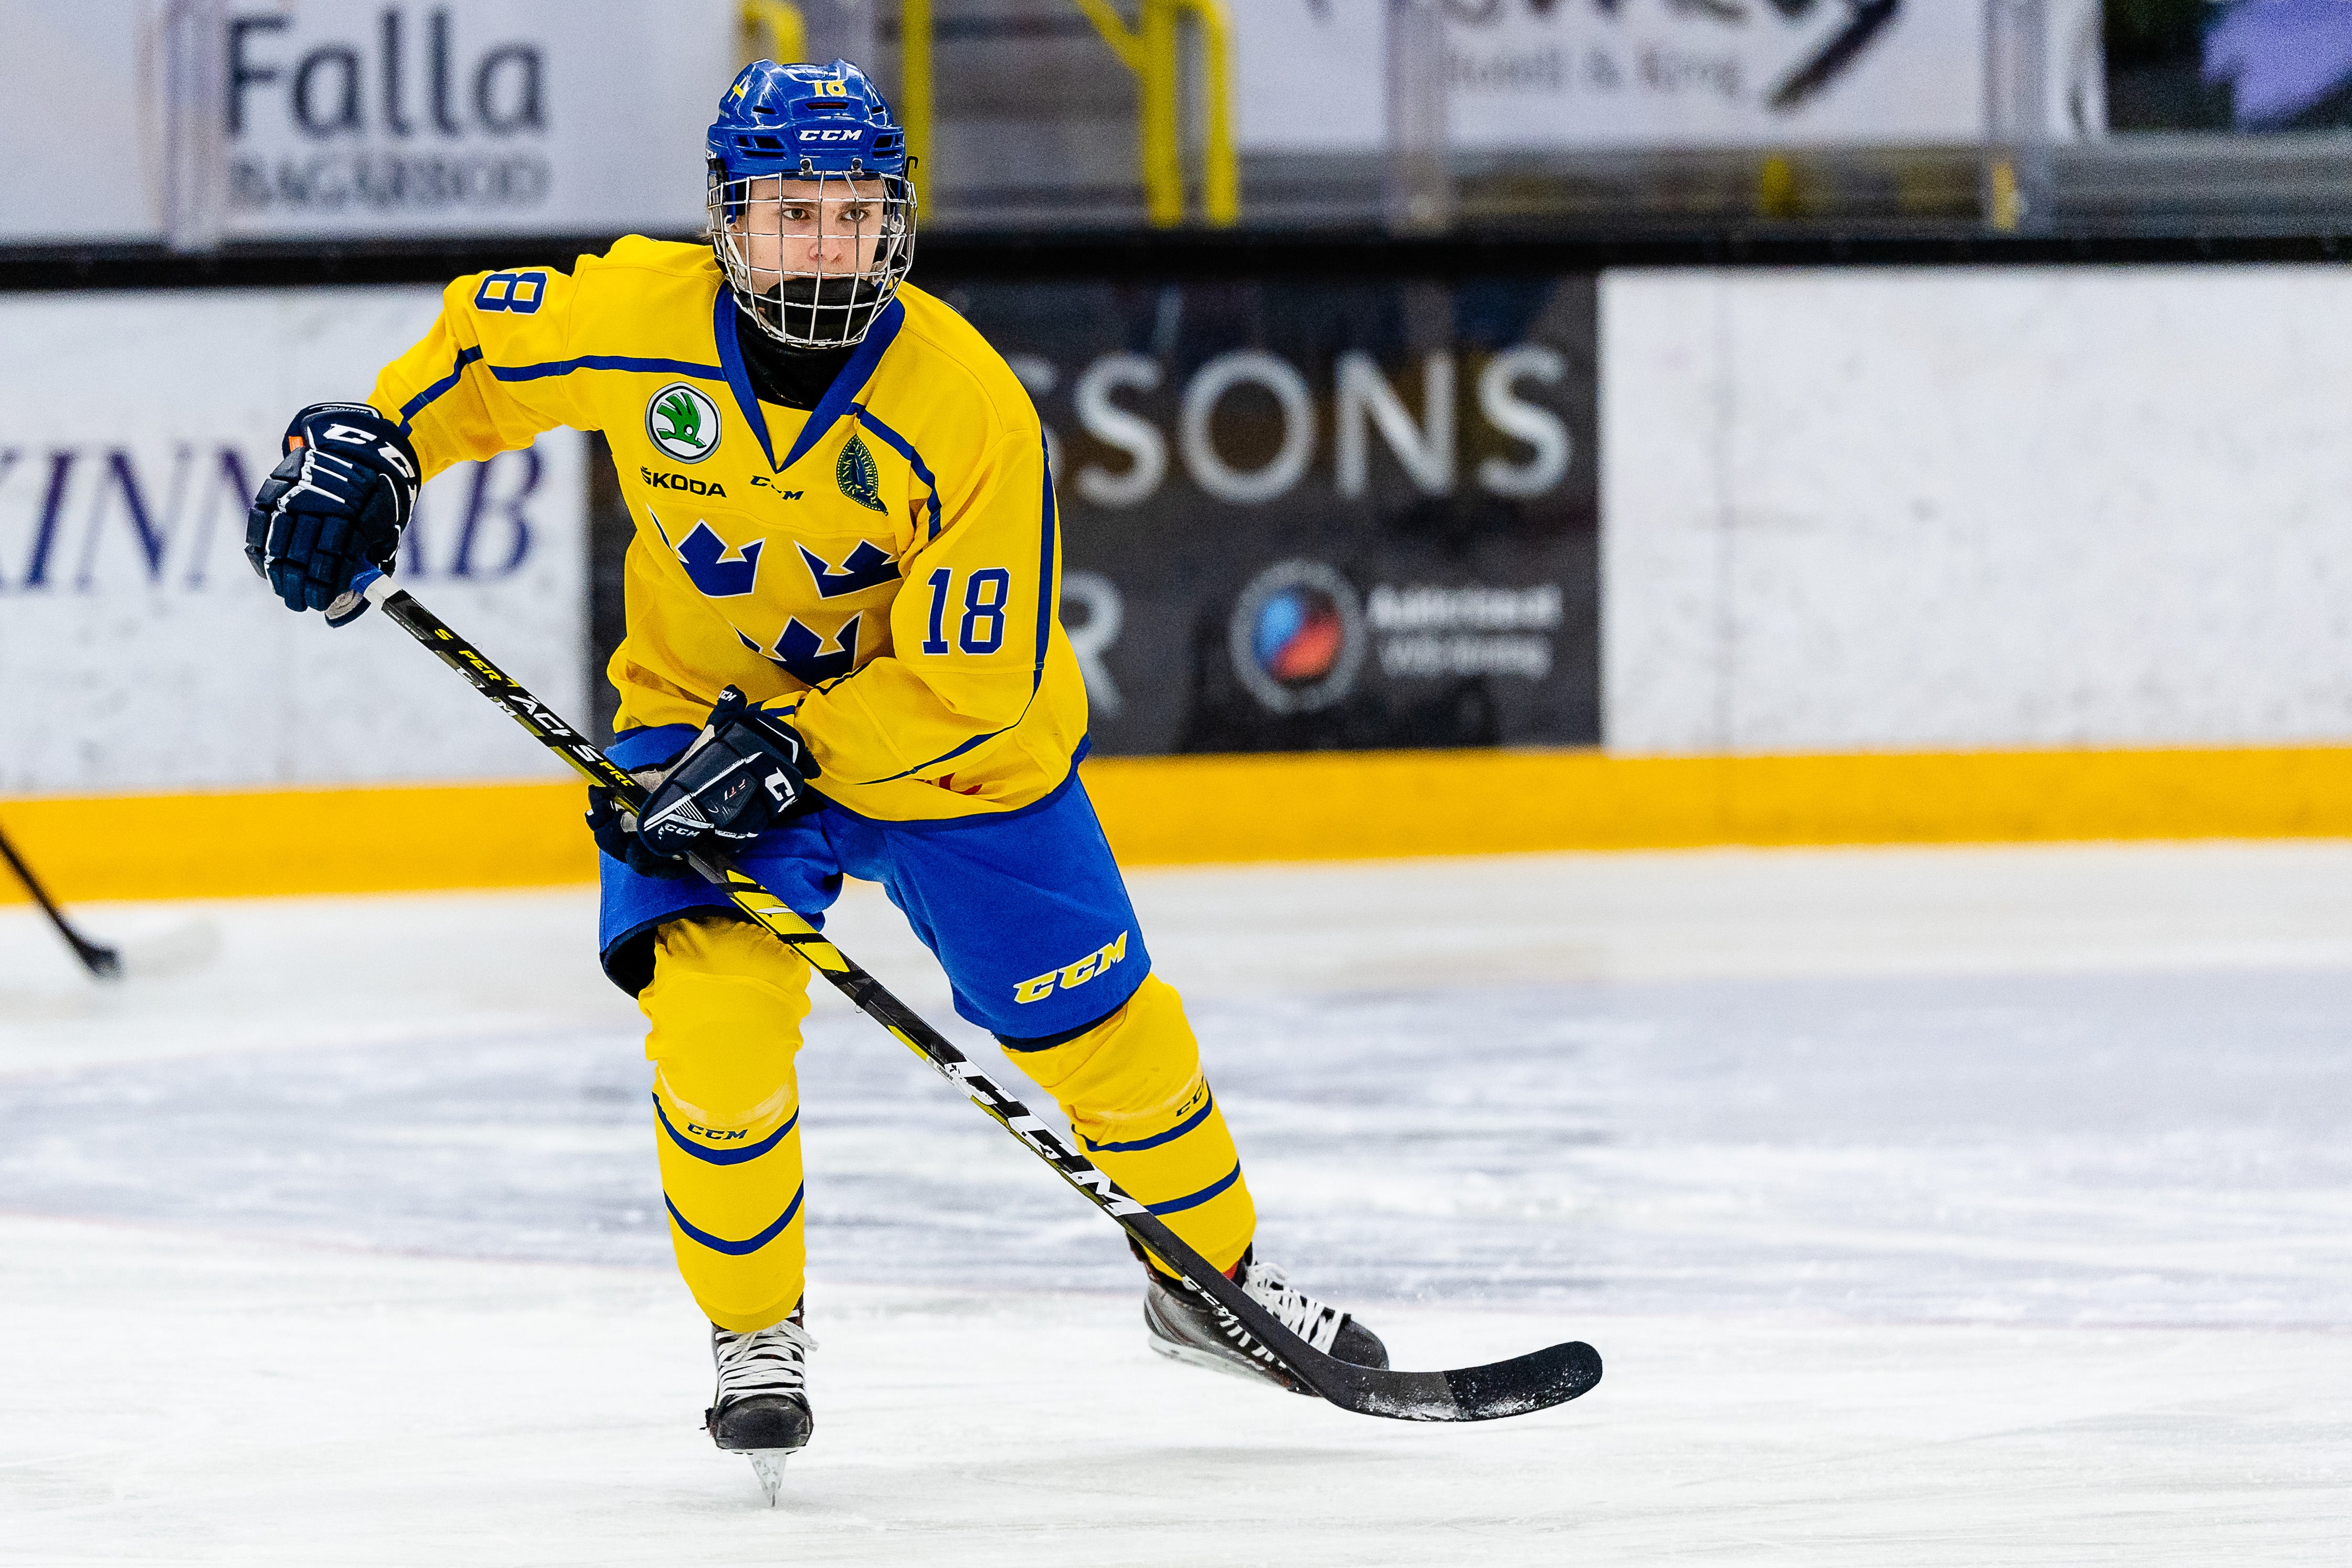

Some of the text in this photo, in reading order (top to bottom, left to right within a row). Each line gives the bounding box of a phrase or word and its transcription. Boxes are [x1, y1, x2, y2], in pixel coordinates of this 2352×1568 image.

[226, 7, 547, 137] Falla
[799, 130, 862, 141] CCM
[640, 465, 727, 498] ŠKODA
[750, 475, 804, 501] CM
[921, 567, 1011, 656] 18
[435, 629, 502, 681] SPER
[664, 823, 700, 838] CCM
[1012, 929, 1128, 1004] CCM
[686, 1121, 748, 1140] CCM
[944, 1054, 1149, 1217] CCM
[1182, 1274, 1239, 1321] CCM
